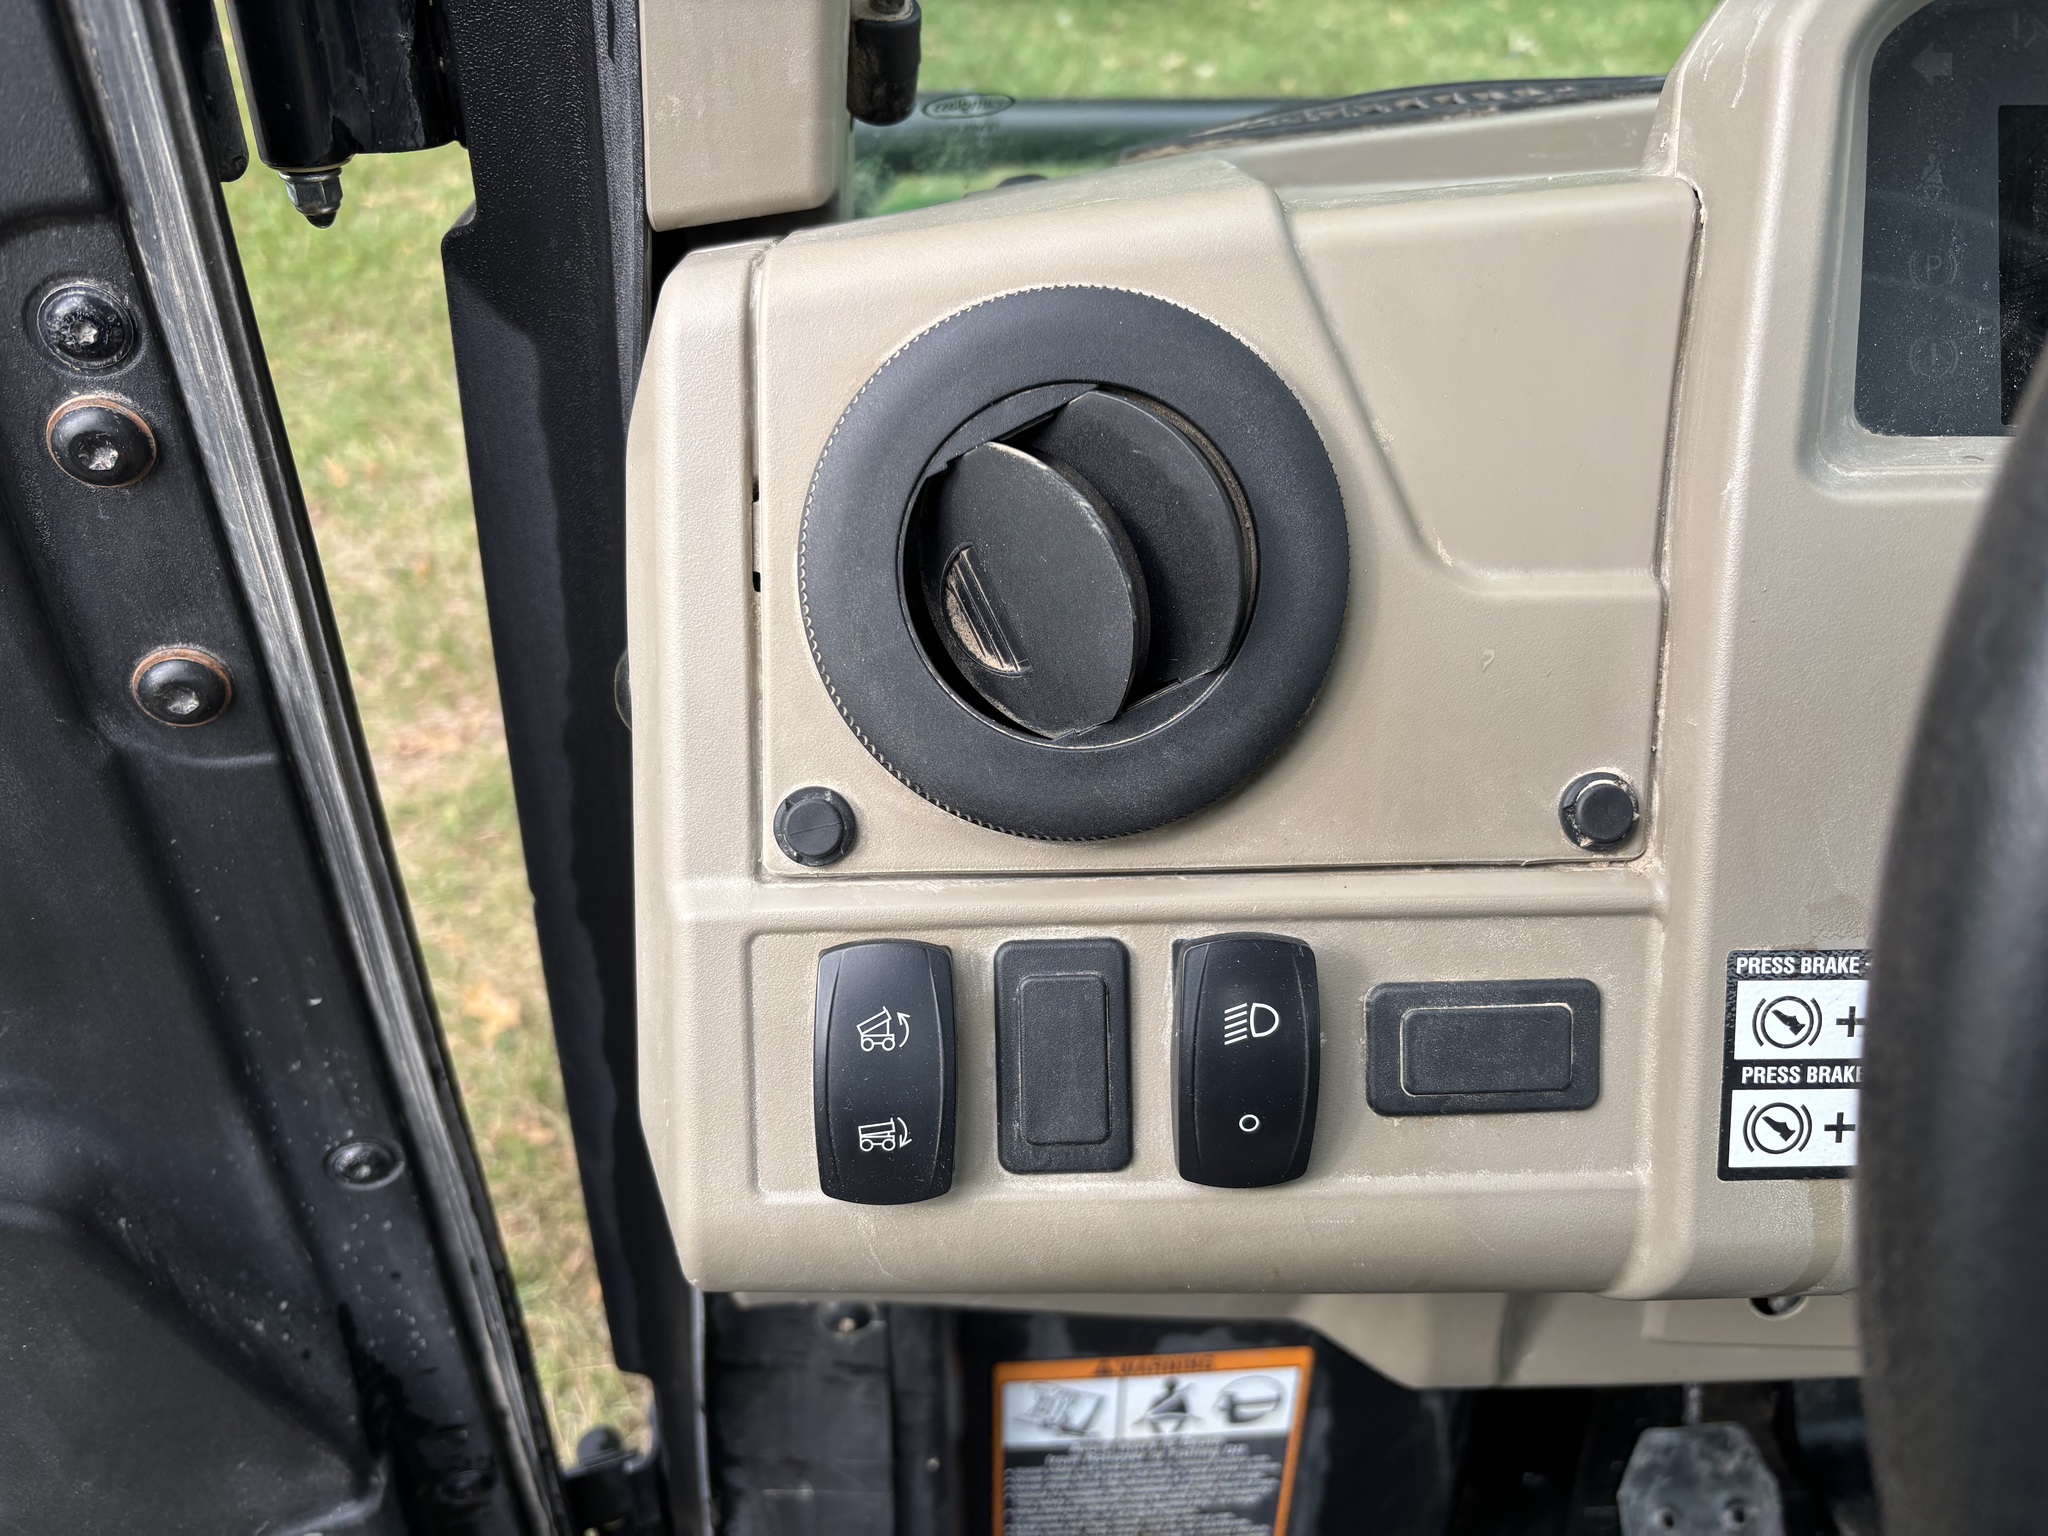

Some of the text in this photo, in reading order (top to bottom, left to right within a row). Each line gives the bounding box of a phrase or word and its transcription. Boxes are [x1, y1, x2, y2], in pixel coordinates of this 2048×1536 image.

[1736, 956, 1860, 974] PRESS BRAKE
[1741, 1066, 1801, 1084] PRESS
[1119, 1355, 1215, 1374] WARNING
